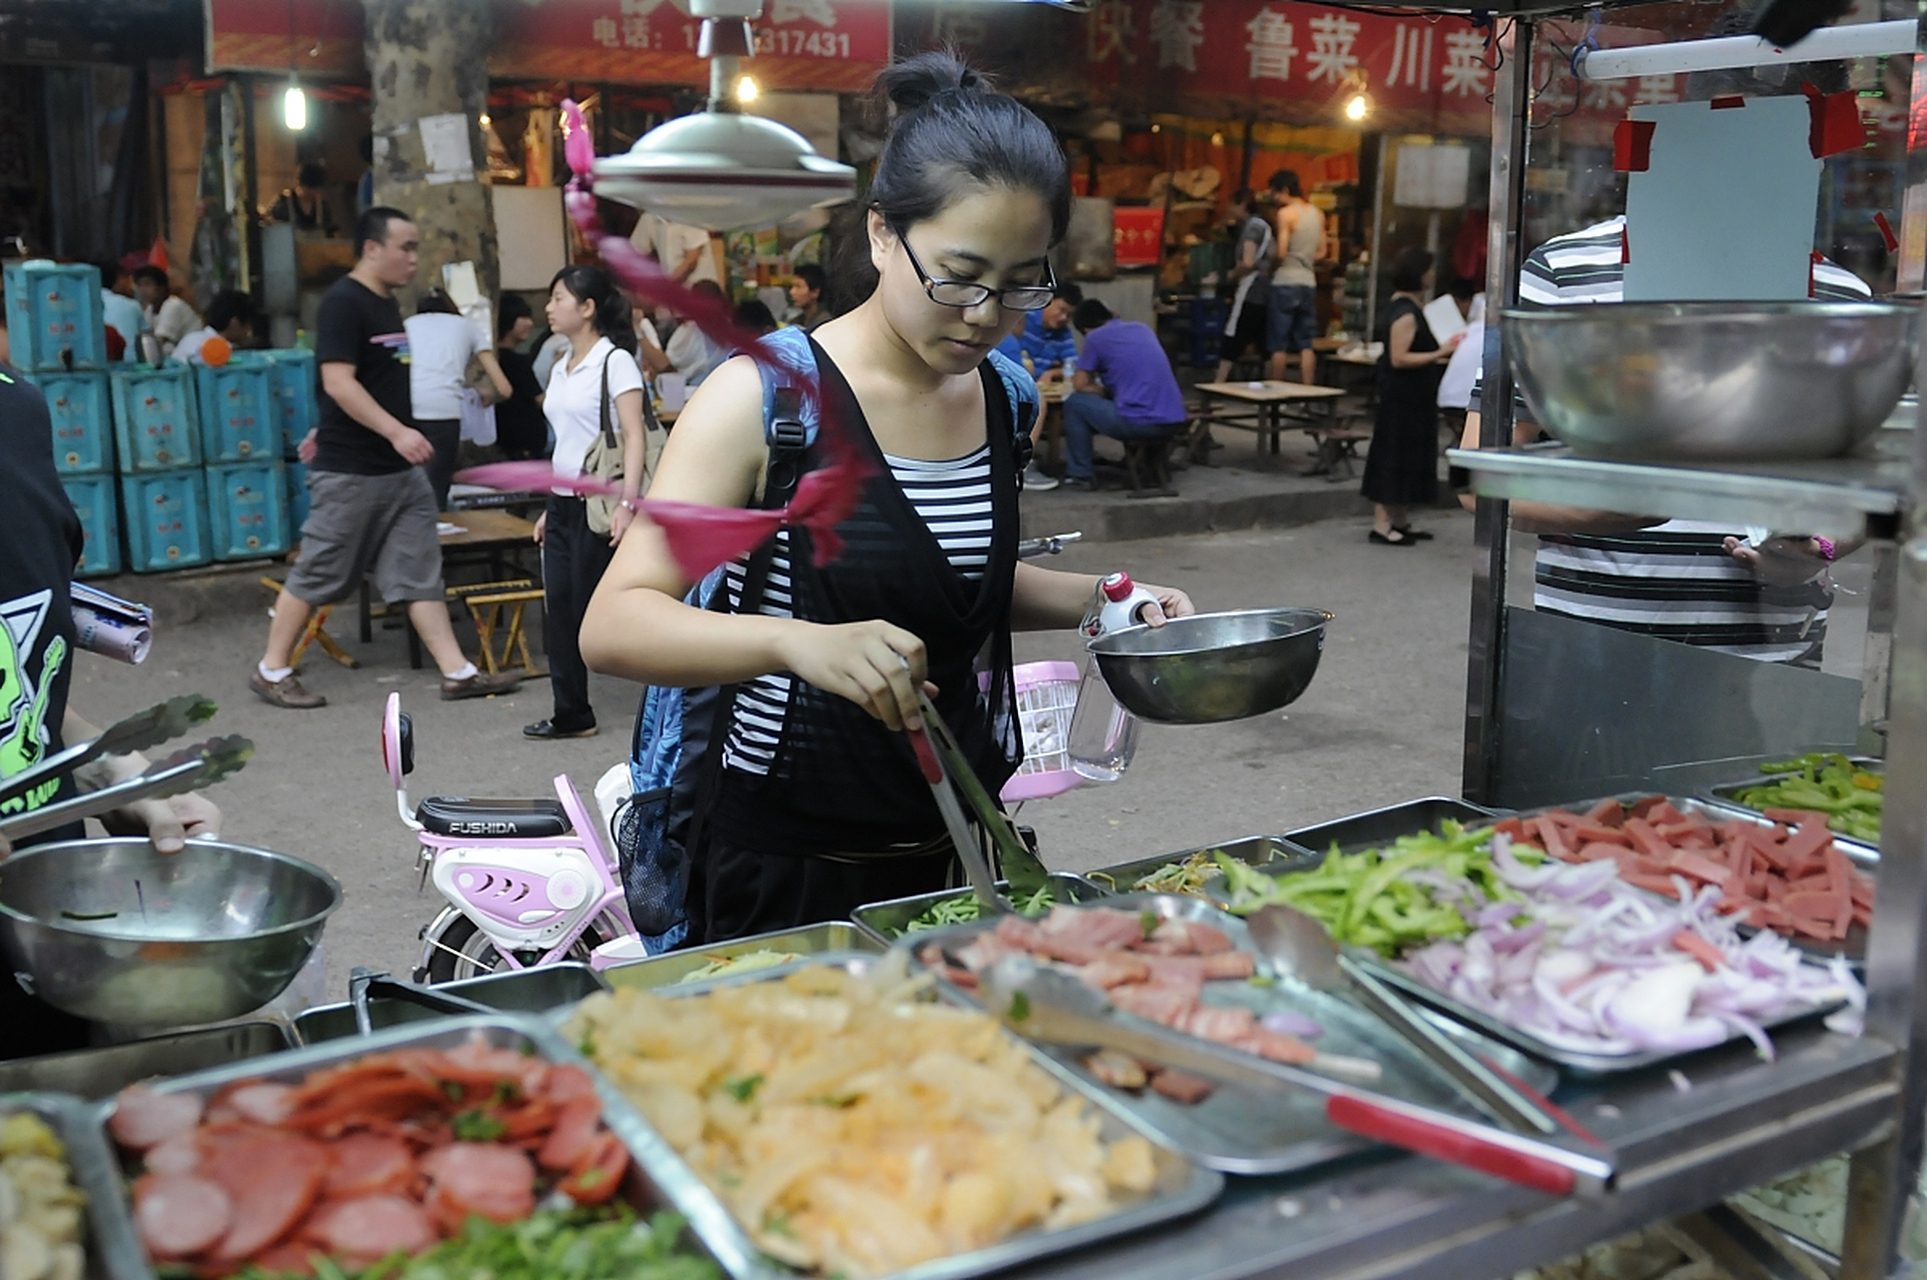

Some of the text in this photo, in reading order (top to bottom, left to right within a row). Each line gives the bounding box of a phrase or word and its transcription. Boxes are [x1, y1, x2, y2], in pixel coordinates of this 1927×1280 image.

[1245, 7, 1361, 84] 鲁菜
[1385, 23, 1490, 97] 川菜
[449, 822, 517, 834] FUSHIDA
